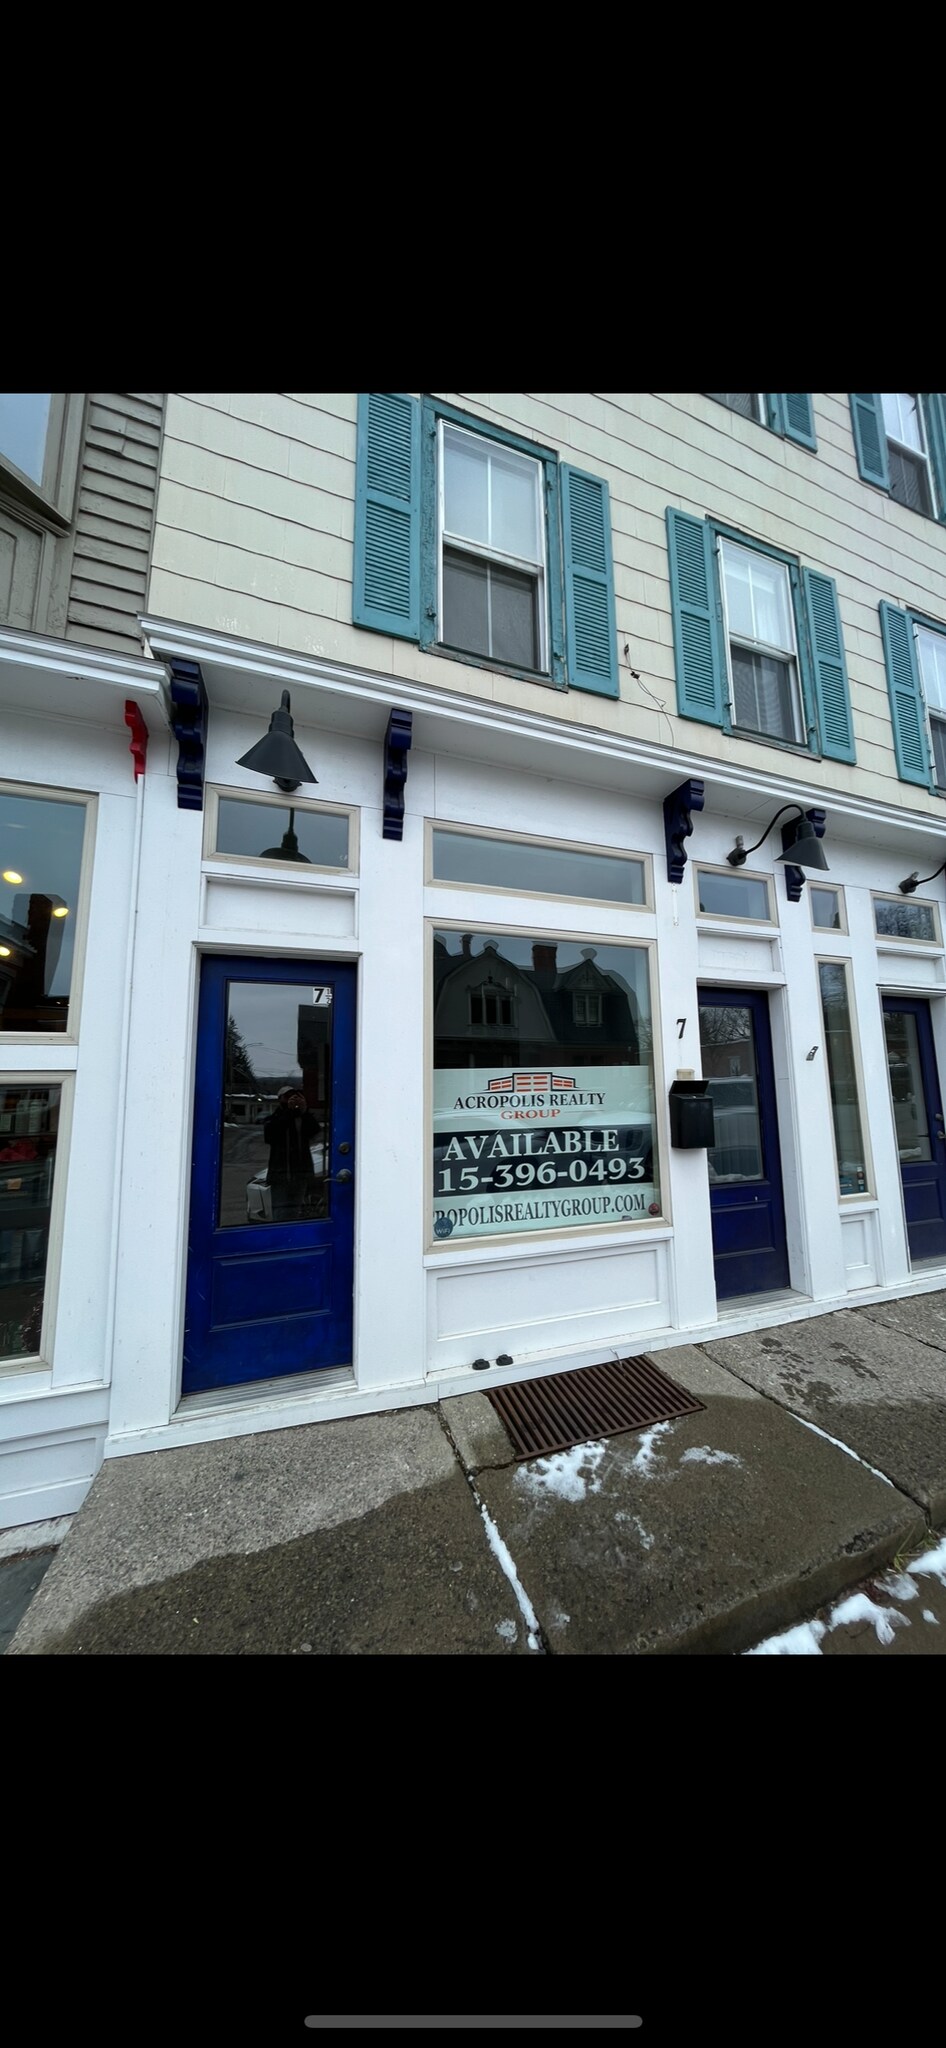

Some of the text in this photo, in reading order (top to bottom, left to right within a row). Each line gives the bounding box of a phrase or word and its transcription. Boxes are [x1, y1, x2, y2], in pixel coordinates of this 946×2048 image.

[676, 1018, 687, 1039] 7
[453, 1092, 606, 1110] ACROPOLIS REALTY
[500, 1108, 561, 1120] GROUP
[442, 1129, 620, 1161] AVAILABLE
[438, 1157, 646, 1192] 15-396-0493
[433, 1193, 646, 1228] ROPOLISREALTYGROUP.COM
